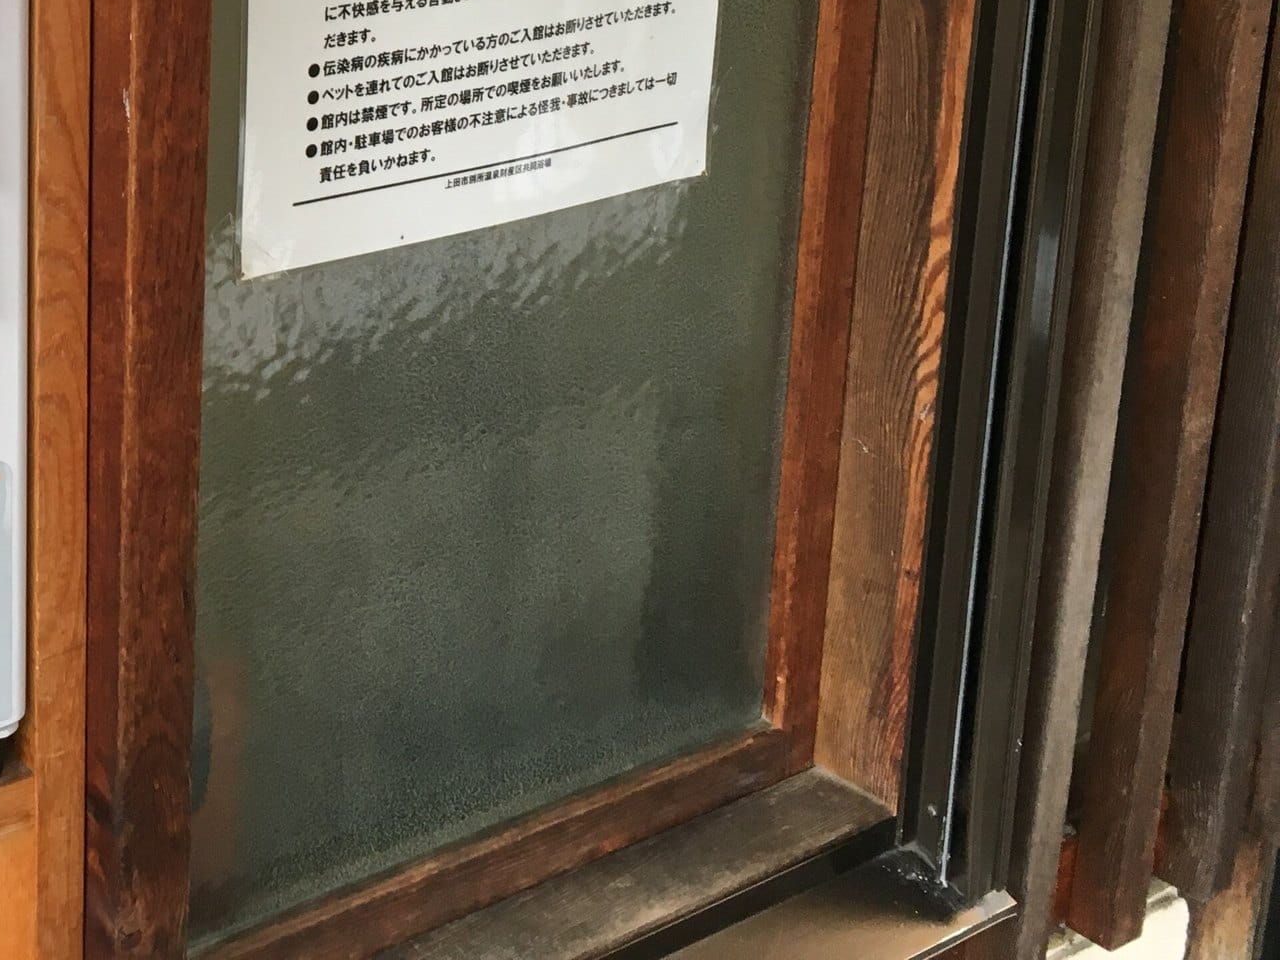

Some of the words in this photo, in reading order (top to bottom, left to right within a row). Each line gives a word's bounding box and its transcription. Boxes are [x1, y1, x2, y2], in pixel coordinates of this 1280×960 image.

[323, 28, 377, 50] だきます。
[318, 148, 437, 184] 責任を負いかねます。
